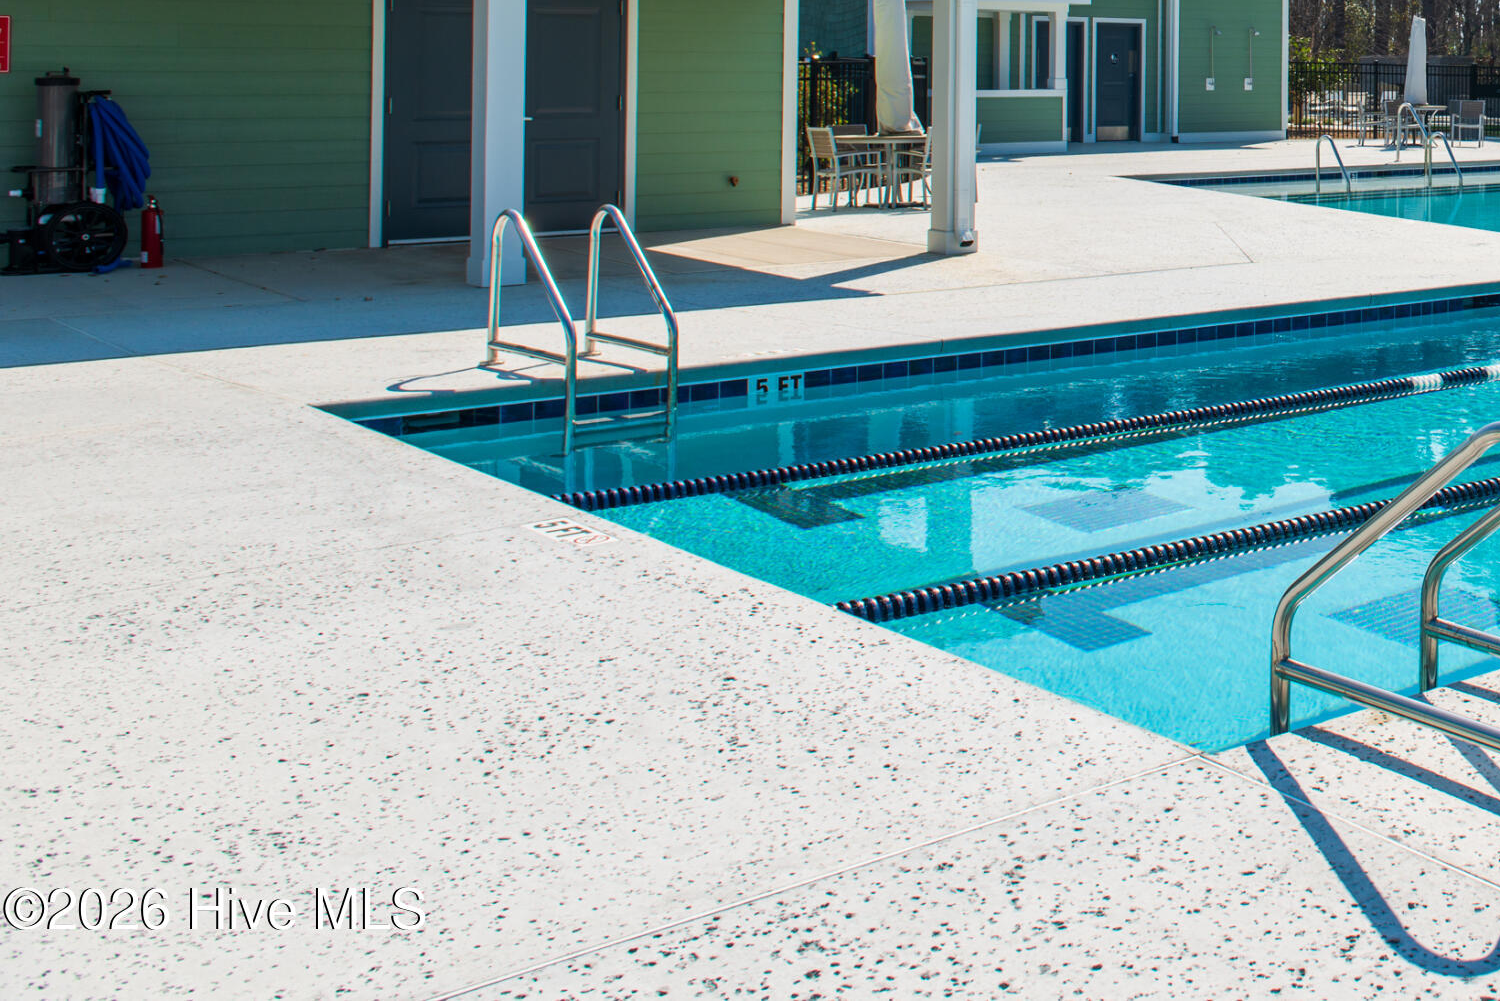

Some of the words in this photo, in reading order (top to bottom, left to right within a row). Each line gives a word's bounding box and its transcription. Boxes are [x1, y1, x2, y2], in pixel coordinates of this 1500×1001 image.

[756, 378, 768, 393] 5
[778, 374, 802, 391] FT
[534, 520, 569, 529] 5
[545, 525, 593, 538] FT
